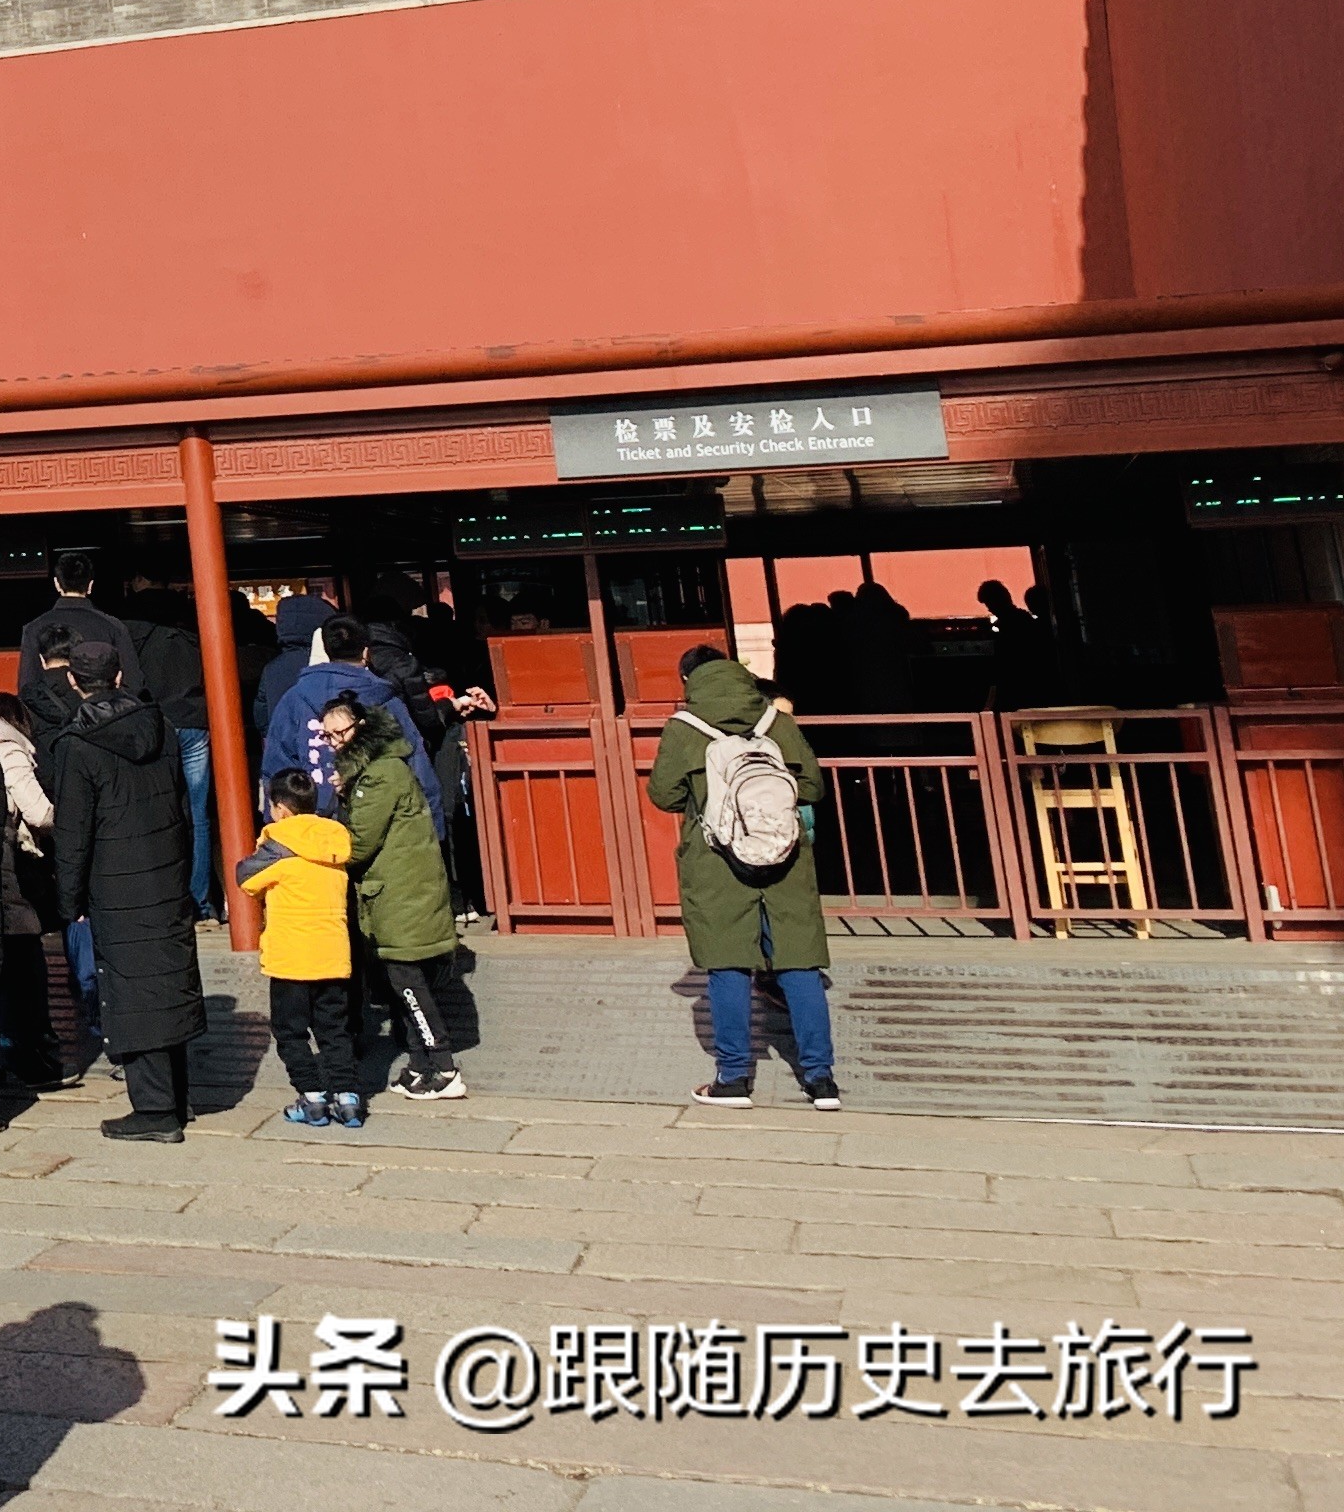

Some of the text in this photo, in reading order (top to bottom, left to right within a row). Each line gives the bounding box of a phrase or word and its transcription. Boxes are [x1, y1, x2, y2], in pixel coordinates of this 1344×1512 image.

[614, 406, 873, 445] 检票及安检入口
[616, 434, 875, 462] Ticket and Security Check Entrance
